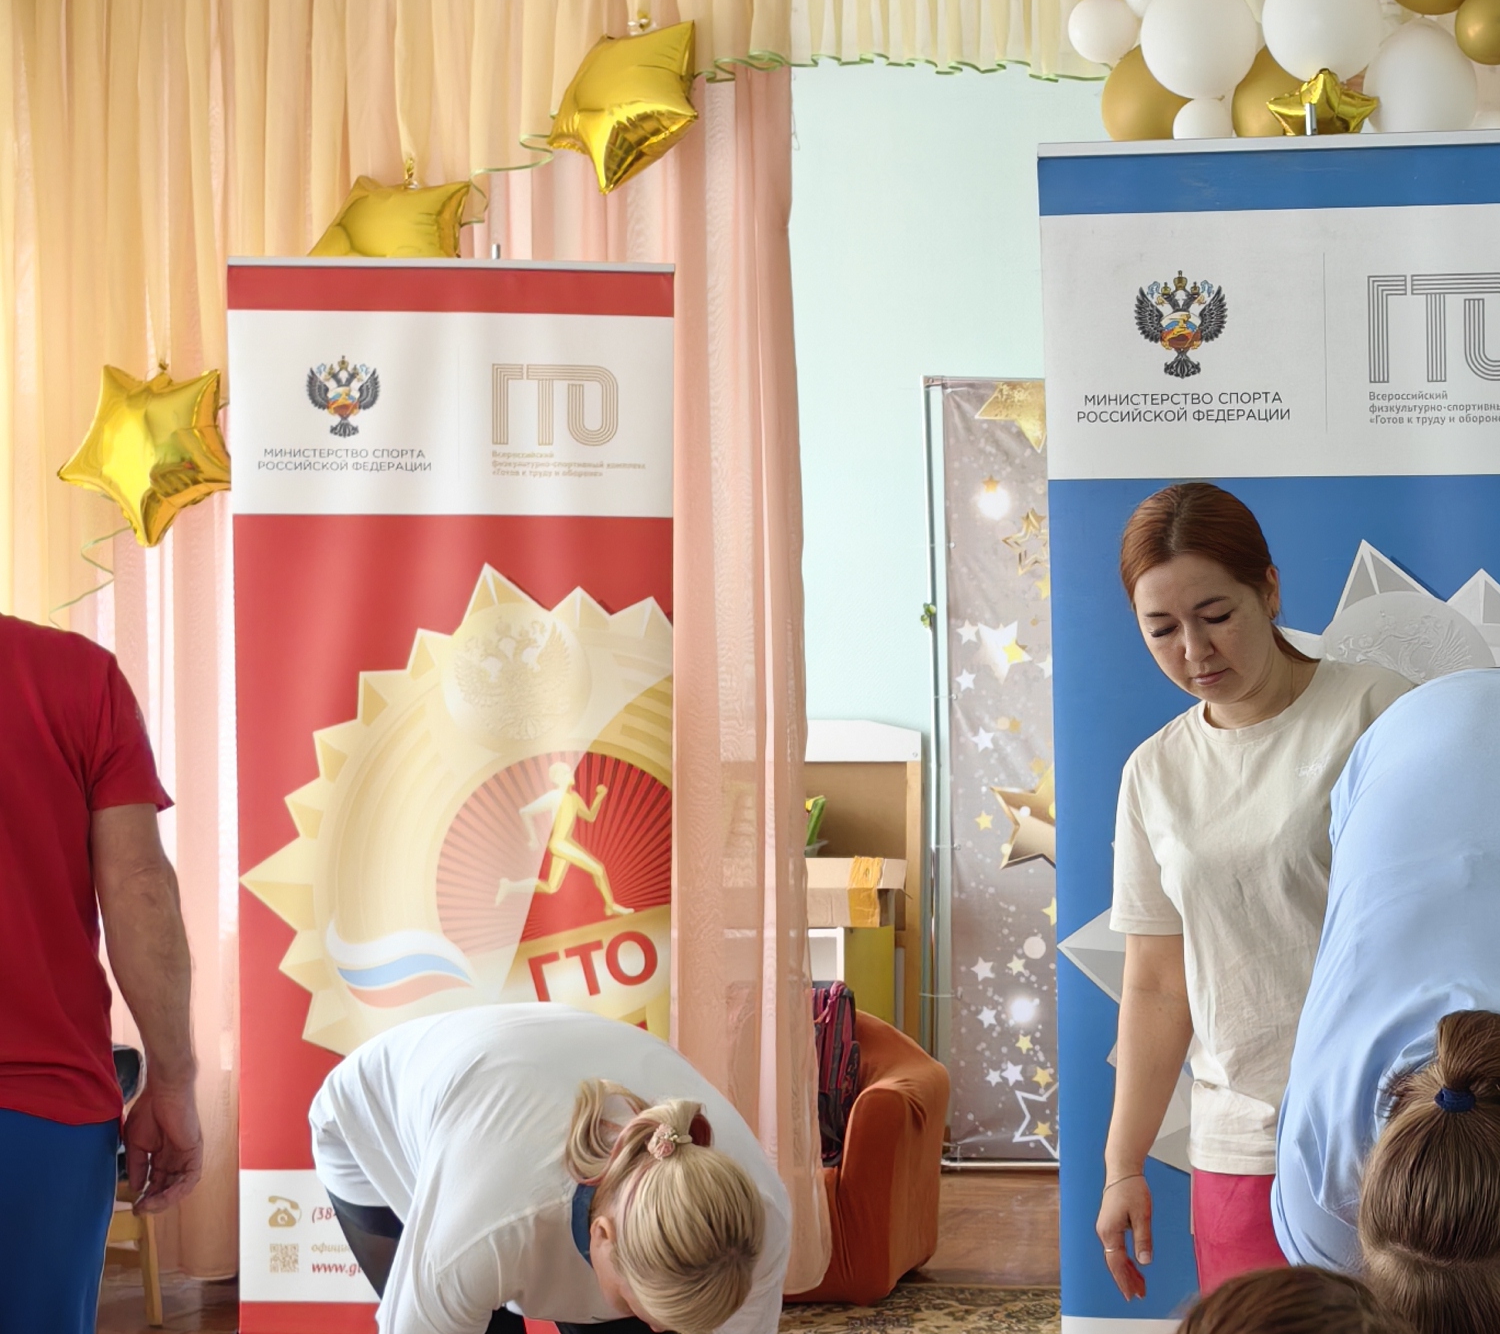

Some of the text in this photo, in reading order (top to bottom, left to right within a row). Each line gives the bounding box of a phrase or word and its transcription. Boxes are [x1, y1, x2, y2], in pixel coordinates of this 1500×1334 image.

[1084, 392, 1283, 406] МИНИСТЕРСТВО СПОРТА
[1369, 391, 1448, 403] Всероссийский
[1077, 407, 1290, 423] РОССИЙСКОЙ ФЕДЕРАЦИИ
[1369, 415, 1404, 424] «Готов
[1407, 416, 1413, 424] к
[1416, 415, 1445, 425] труду
[1449, 415, 1455, 423] и
[264, 448, 425, 459] МИНИСТЕРСТВО СПОРТА
[257, 459, 432, 472] РОССИЙСКОЙ ФЕДЕРАЦИИ
[527, 930, 658, 1003] ГТО
[312, 1207, 337, 1224] (38
